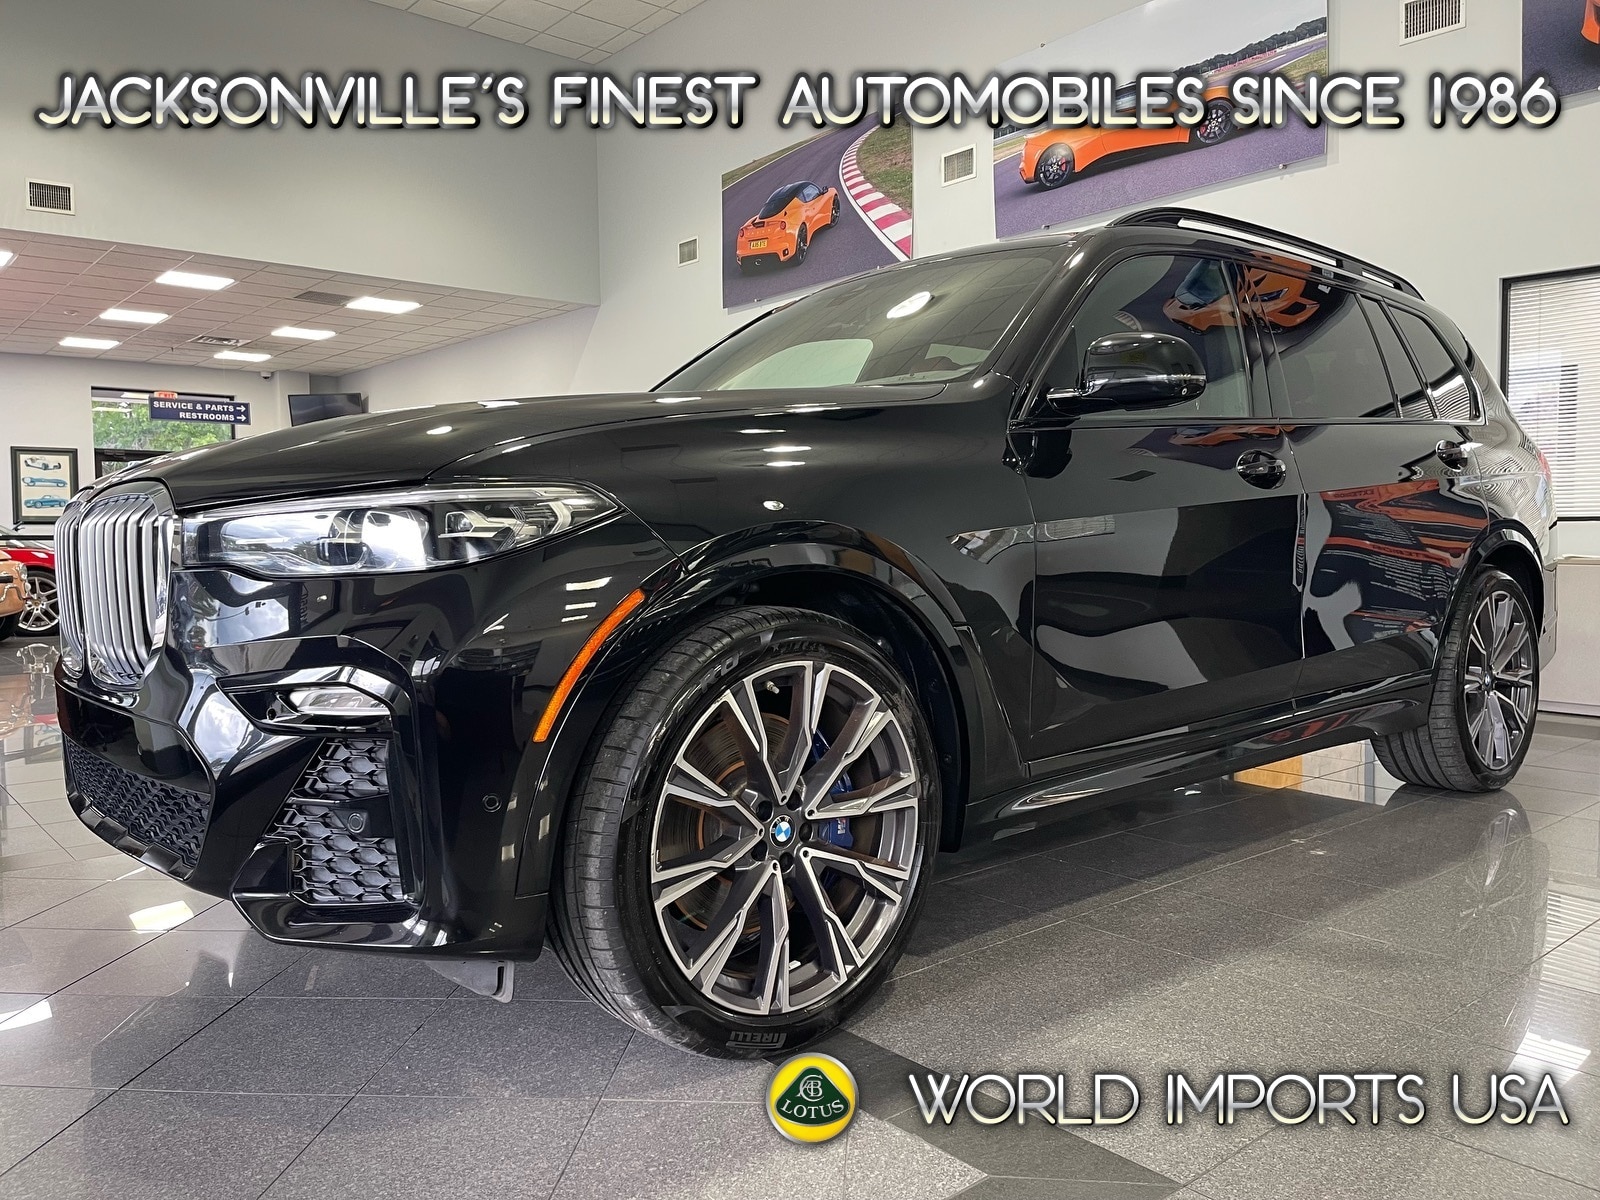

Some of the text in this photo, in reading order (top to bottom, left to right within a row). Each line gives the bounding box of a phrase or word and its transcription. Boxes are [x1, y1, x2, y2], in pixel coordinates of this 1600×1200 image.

[153, 401, 194, 410] SERVICE
[205, 403, 235, 412] PARTS
[179, 411, 235, 421] RESTROOMS
[726, 1031, 787, 1049] PIRELLI
